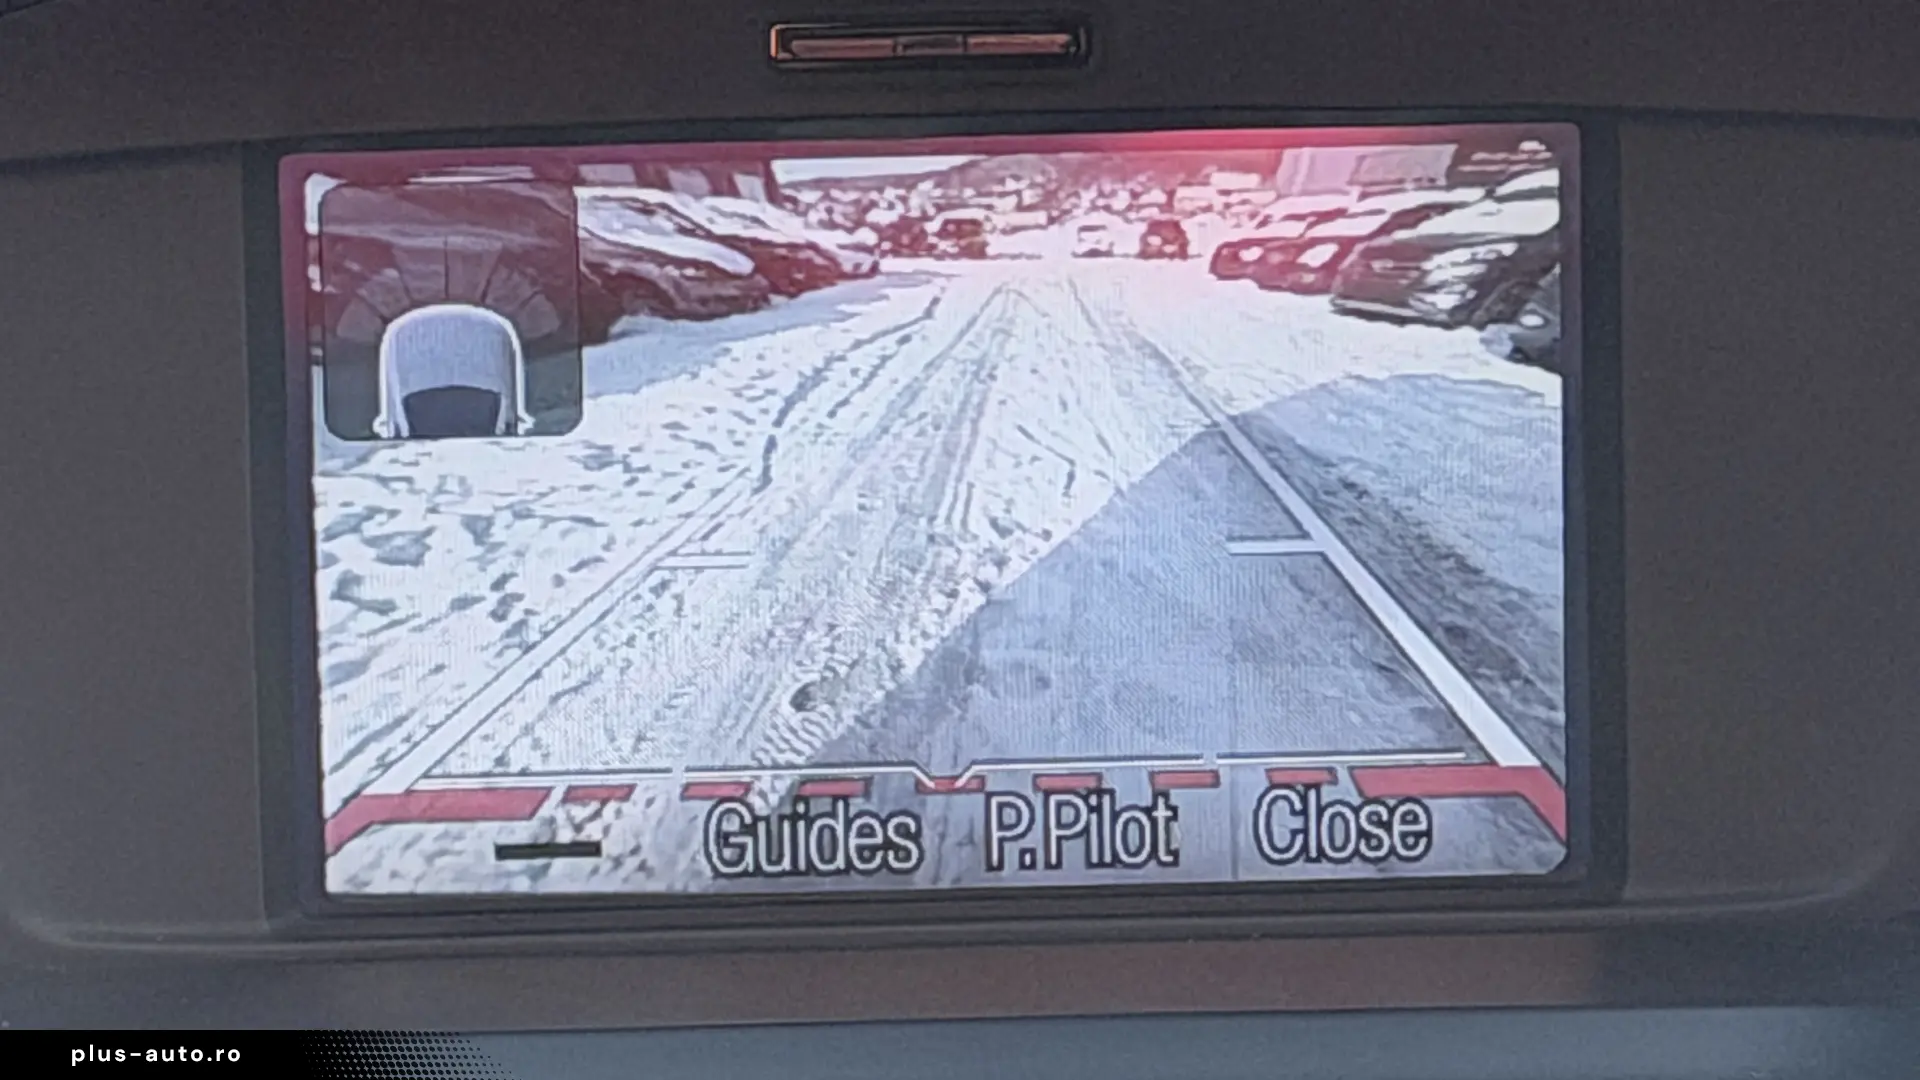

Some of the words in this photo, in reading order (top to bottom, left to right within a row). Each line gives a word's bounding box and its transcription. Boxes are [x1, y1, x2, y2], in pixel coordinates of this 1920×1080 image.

[707, 797, 921, 875] Guides
[987, 791, 1177, 868] P.Pilot
[1256, 786, 1430, 863] Close
